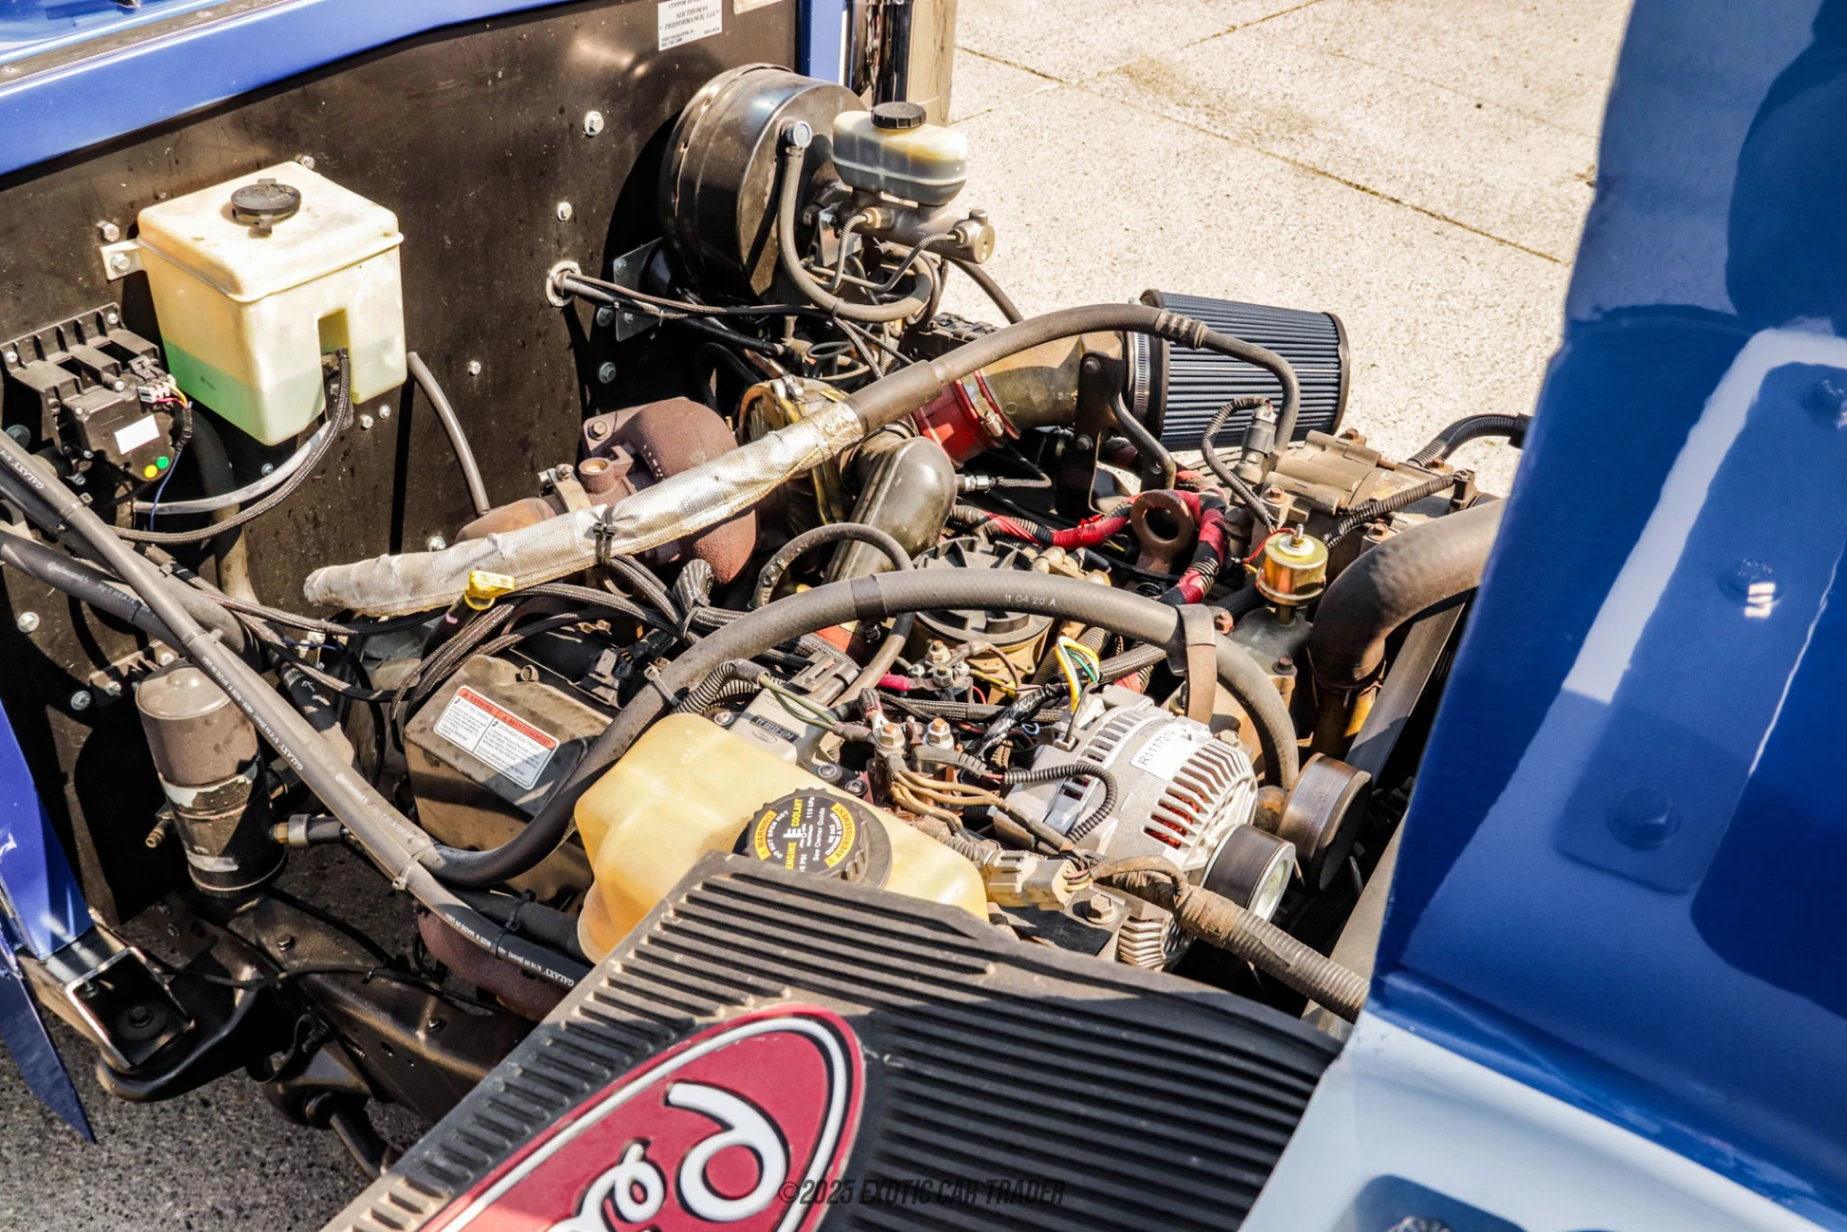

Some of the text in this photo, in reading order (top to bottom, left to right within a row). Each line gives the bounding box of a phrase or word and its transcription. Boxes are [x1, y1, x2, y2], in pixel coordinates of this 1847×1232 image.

[11, 461, 45, 489] GALAXY
[1004, 594, 1056, 606] 11 04 20 A
[278, 743, 303, 770] GALAXY
[775, 810, 789, 822] HOT
[817, 807, 825, 826] Guide
[756, 814, 774, 849] WARNING
[767, 821, 777, 838] OPEN
[785, 798, 803, 870] ENGINE COOLANT
[815, 827, 824, 848] Owner
[835, 807, 853, 858] AVERTISSEMENT
[773, 851, 783, 859] DO
[444, 913, 455, 922] USA
[460, 924, 475, 936] MADE
[543, 968, 574, 986] GALAXY
